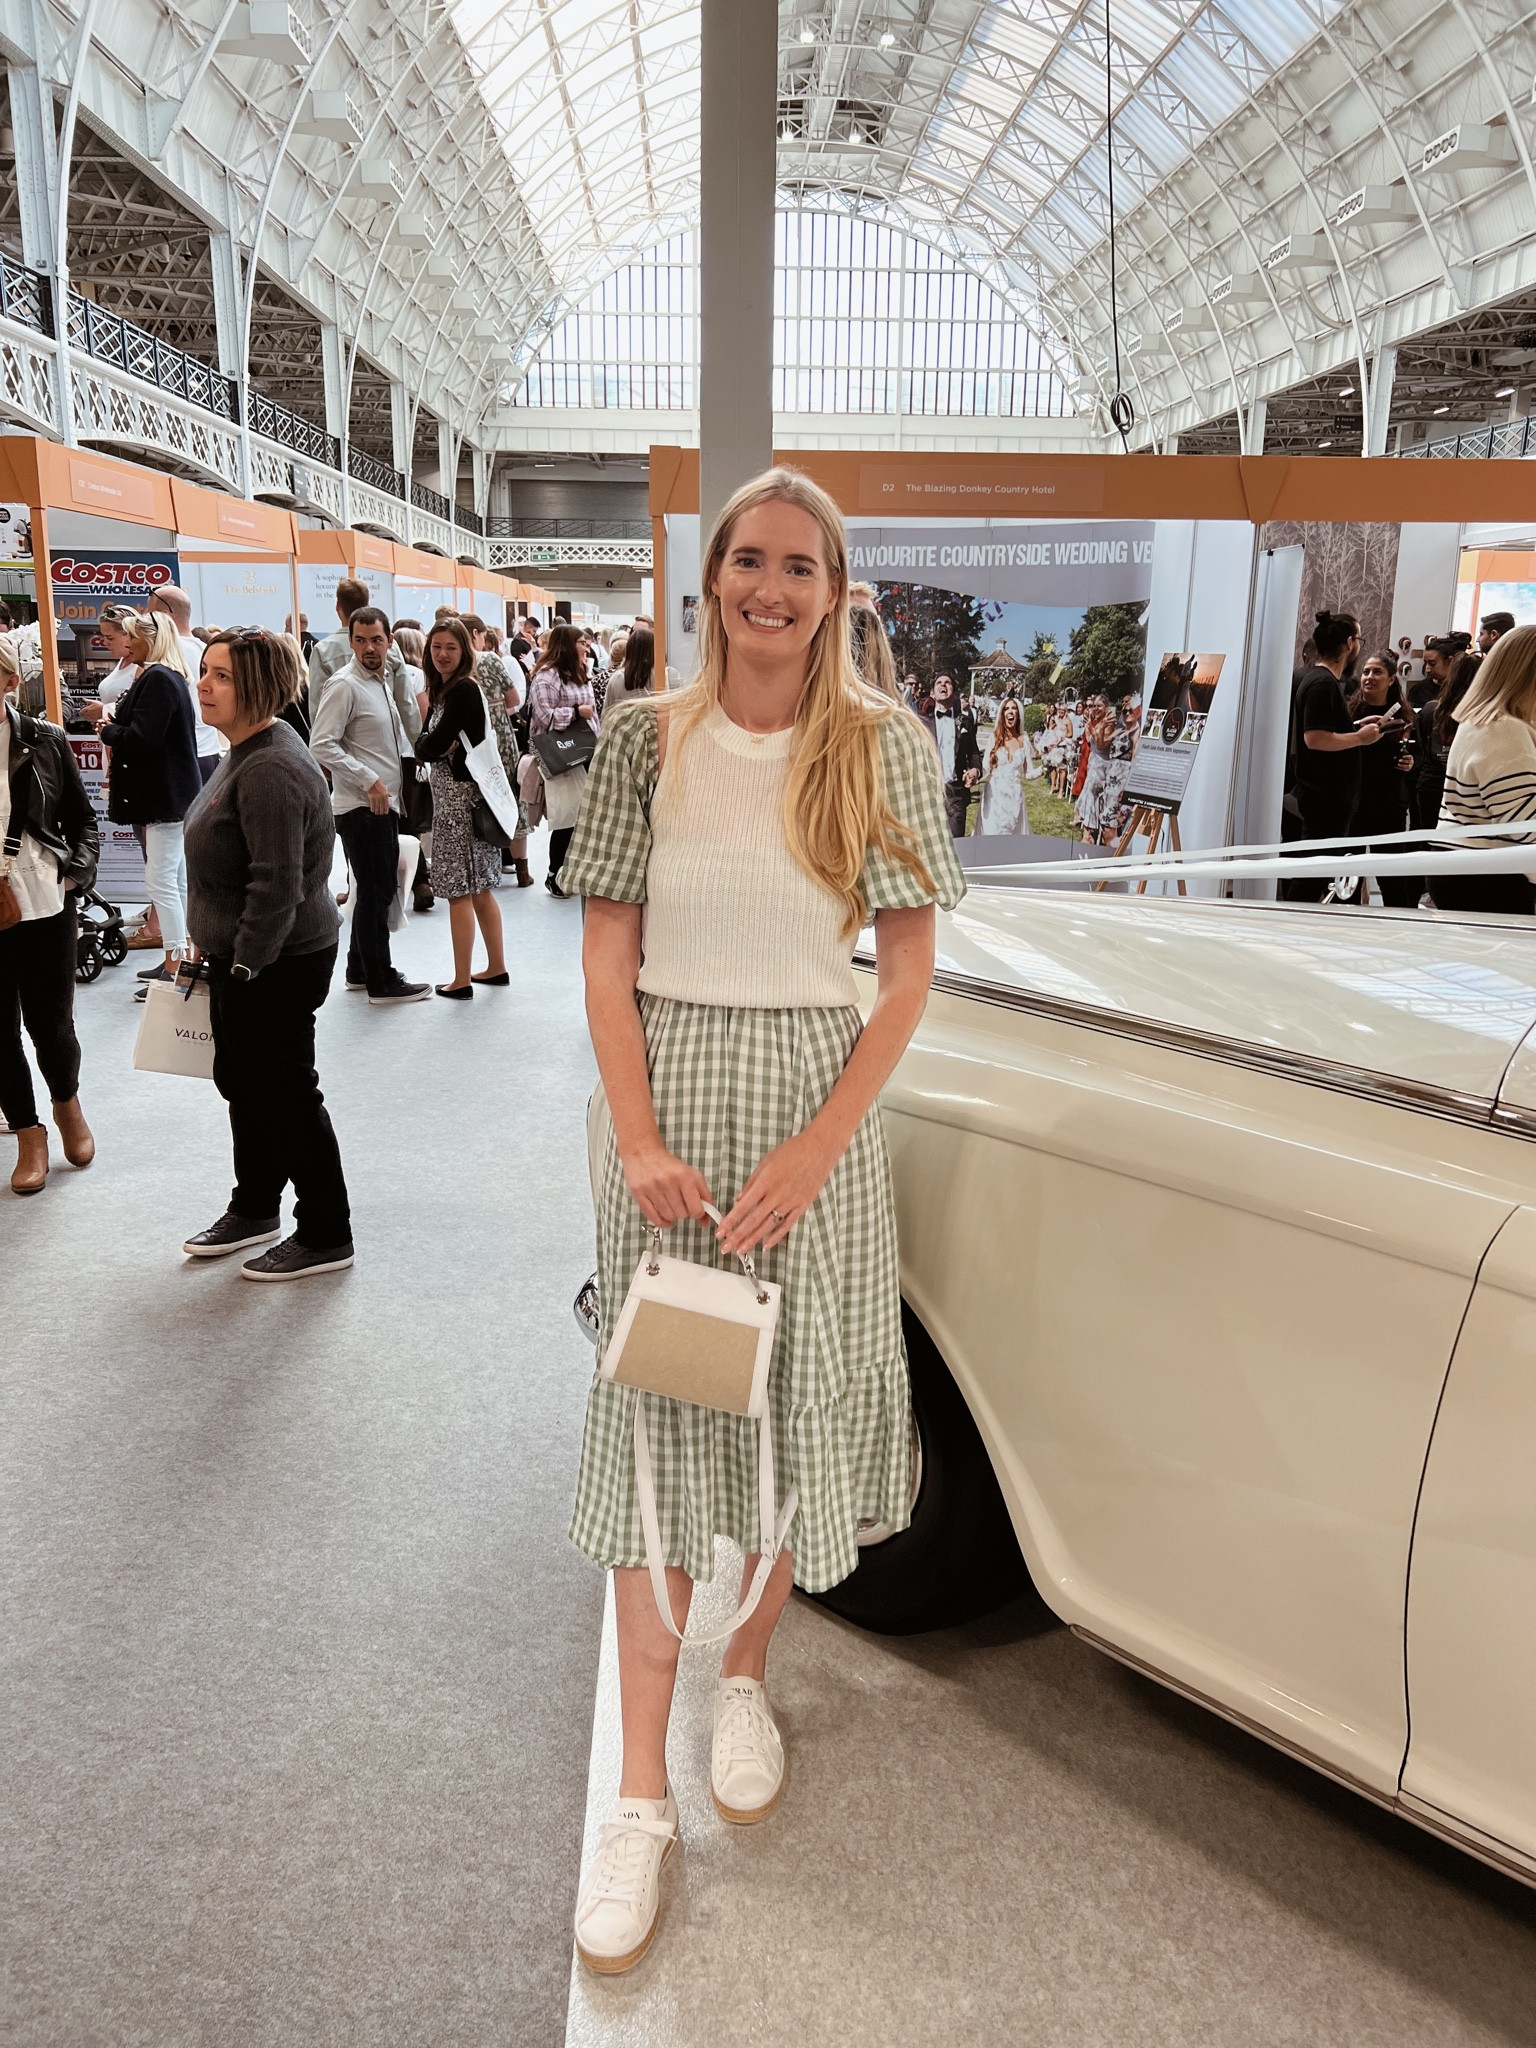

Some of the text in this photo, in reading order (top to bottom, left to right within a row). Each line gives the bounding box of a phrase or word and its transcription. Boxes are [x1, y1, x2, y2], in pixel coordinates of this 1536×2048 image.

[882, 483, 1055, 495] D2 The Blazing Donkey Country Hotel
[845, 540, 1154, 568] FAVOURITE COUNTRYSIDE WEDDING VE
[50, 558, 171, 585] COSTCO
[88, 584, 151, 596] WHOLESA
[57, 600, 98, 619] Join
